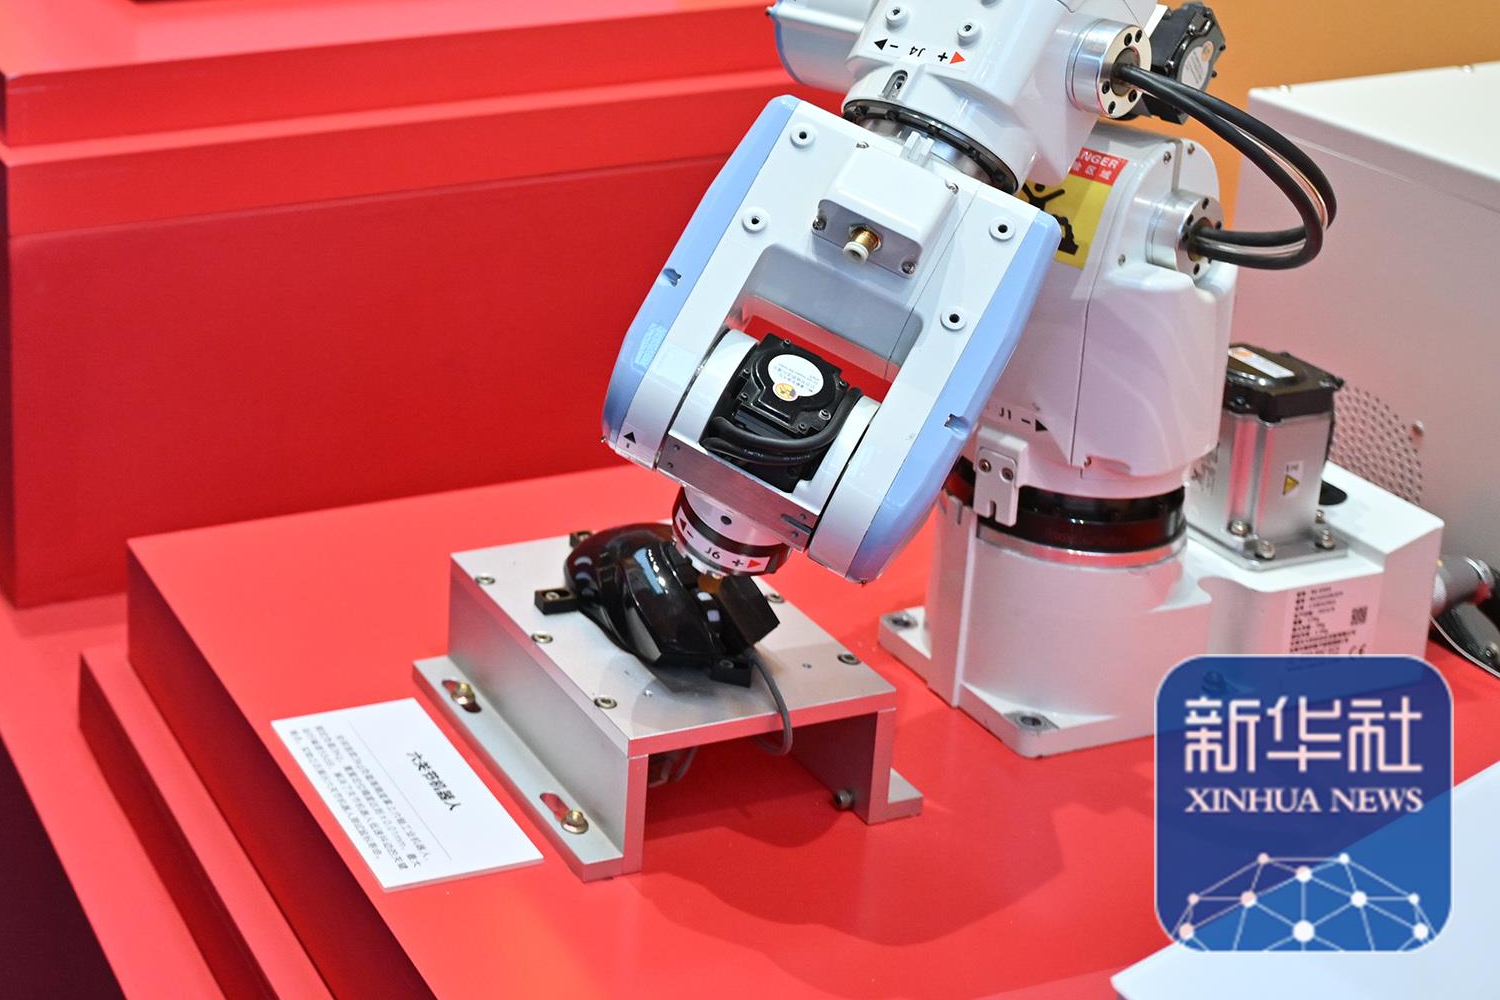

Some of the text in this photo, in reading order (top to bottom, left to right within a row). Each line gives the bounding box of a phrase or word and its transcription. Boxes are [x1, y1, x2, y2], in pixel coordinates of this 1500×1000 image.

[909, 46, 926, 58] J4
[704, 547, 721, 560] J6
[406, 751, 461, 811] 六关节机器人
